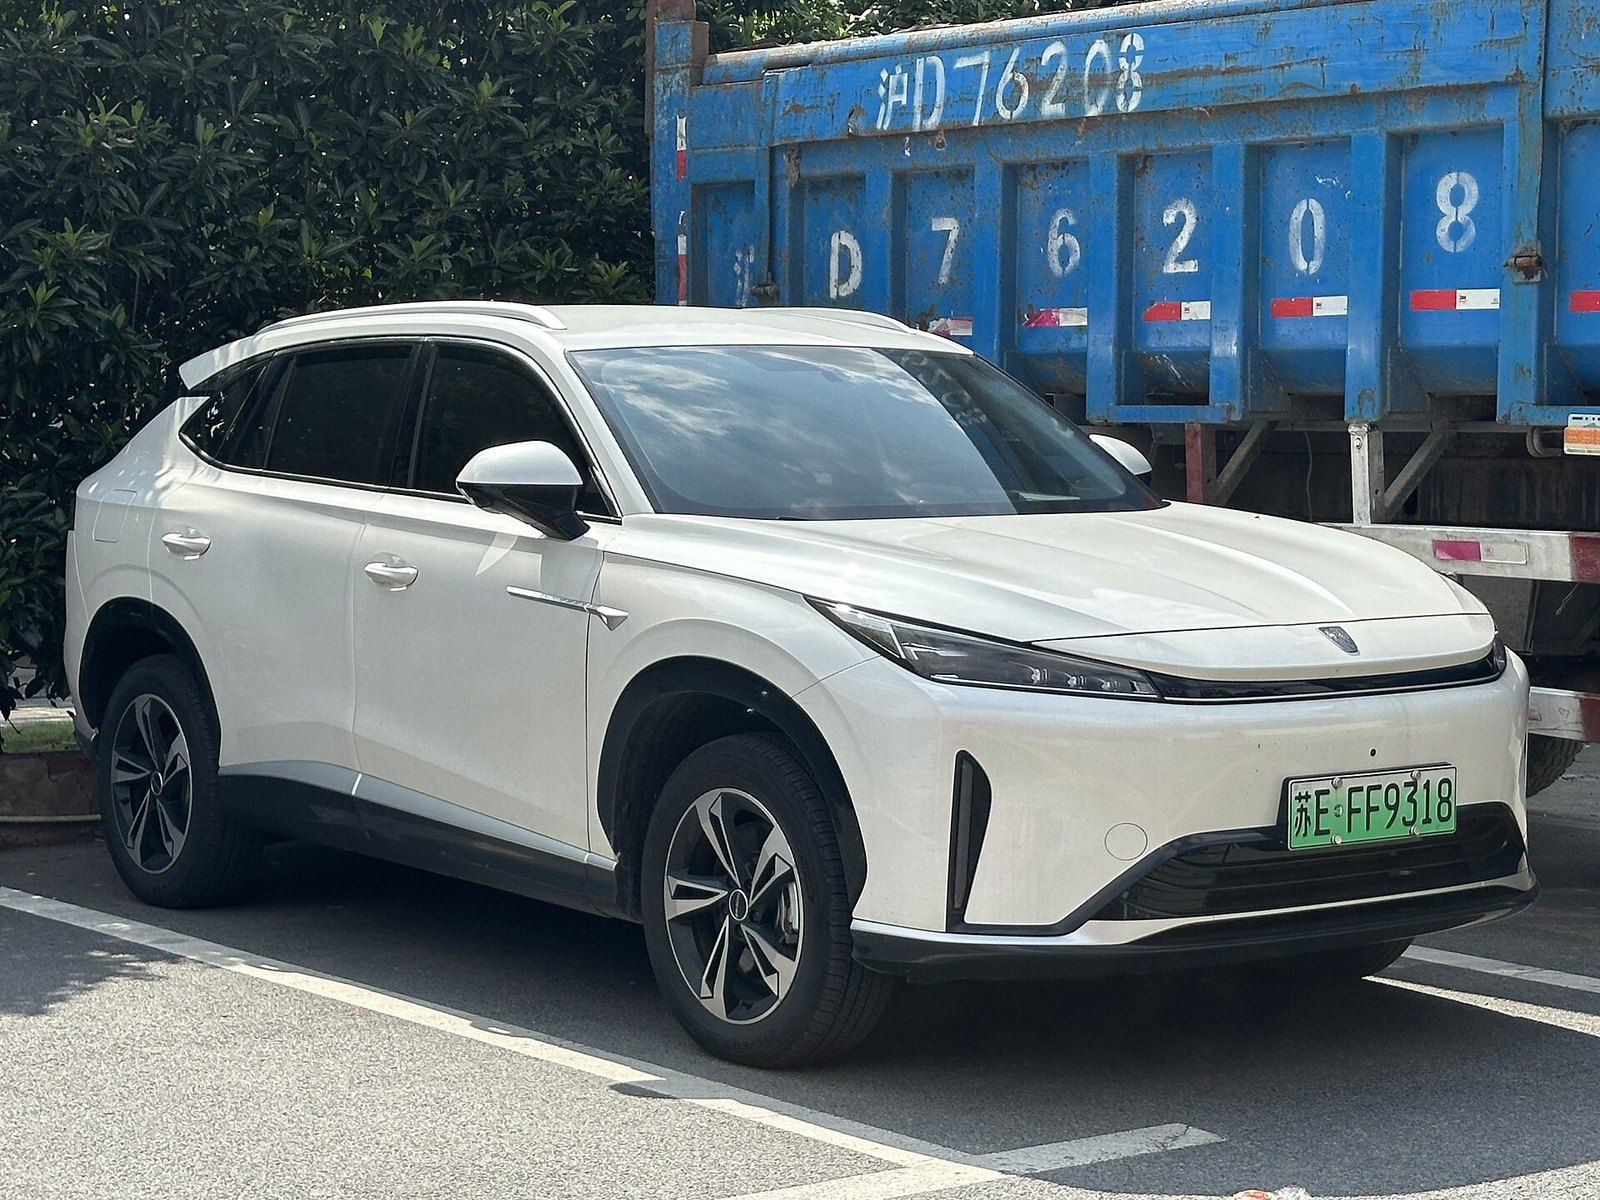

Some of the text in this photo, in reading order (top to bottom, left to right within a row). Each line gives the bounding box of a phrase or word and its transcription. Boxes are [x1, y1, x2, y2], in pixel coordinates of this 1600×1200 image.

[829, 230, 862, 299] D
[931, 217, 960, 285] 7
[1047, 208, 1081, 277] 6
[1162, 197, 1198, 274] 2
[1436, 171, 1479, 253] 8
